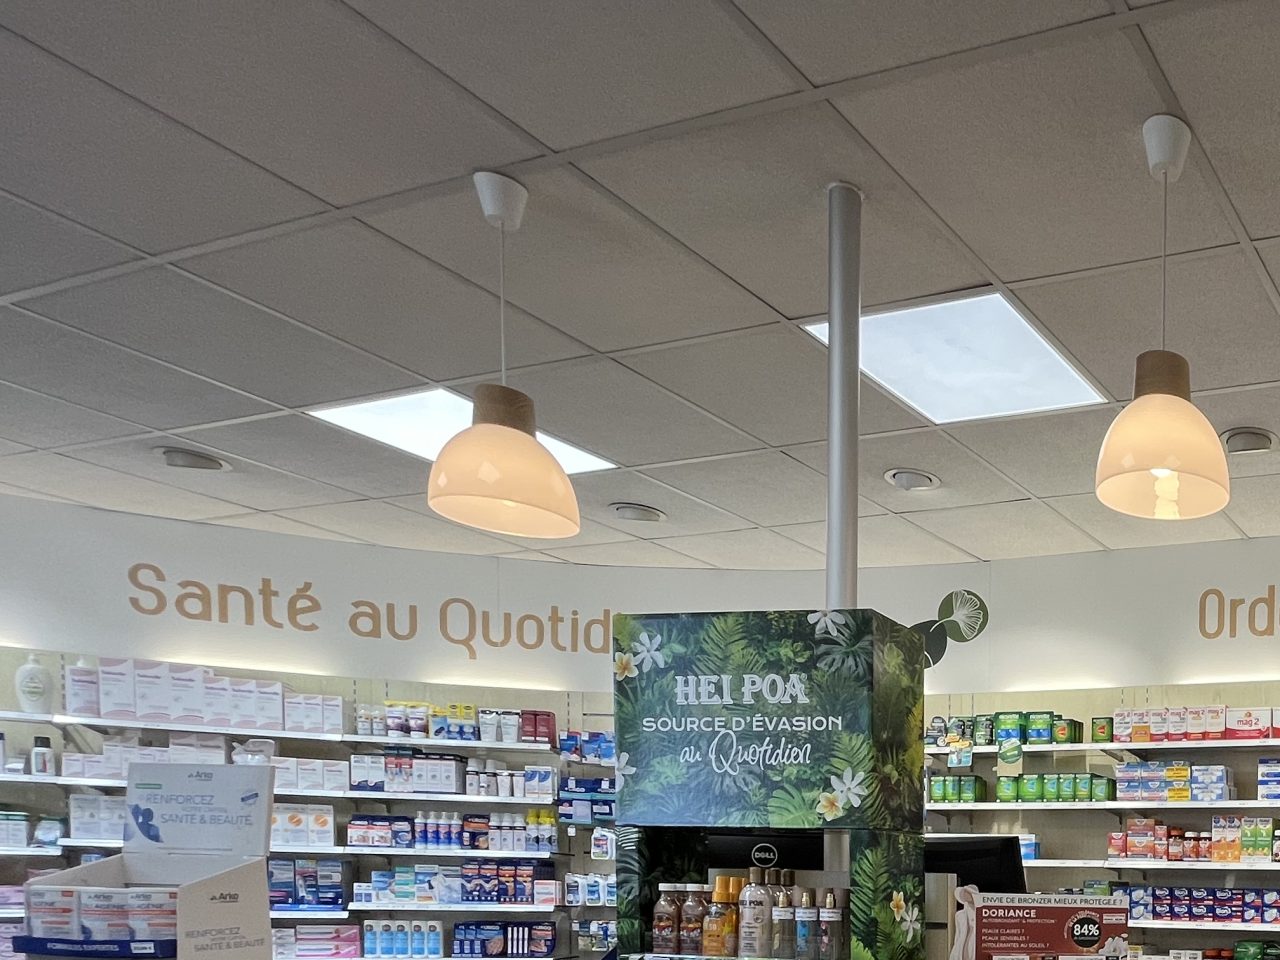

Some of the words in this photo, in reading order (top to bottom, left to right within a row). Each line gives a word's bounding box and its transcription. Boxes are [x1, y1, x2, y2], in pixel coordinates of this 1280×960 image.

[127, 562, 323, 632] Santé
[348, 596, 419, 641] au
[439, 596, 611, 660] Quotid
[675, 674, 734, 706] HEI
[741, 673, 810, 705] POA
[642, 716, 727, 732] SOURCE
[732, 712, 843, 732] D'ÉVASION
[1236, 719, 1252, 728] mag
[679, 745, 703, 763] au
[708, 729, 812, 776] Quotidien
[982, 896, 1004, 904] ENVIE
[1005, 896, 1016, 904] DE
[1017, 897, 1052, 905] BRONZER
[982, 908, 1037, 918] DORIANCE
[1073, 923, 1100, 936] 84%
